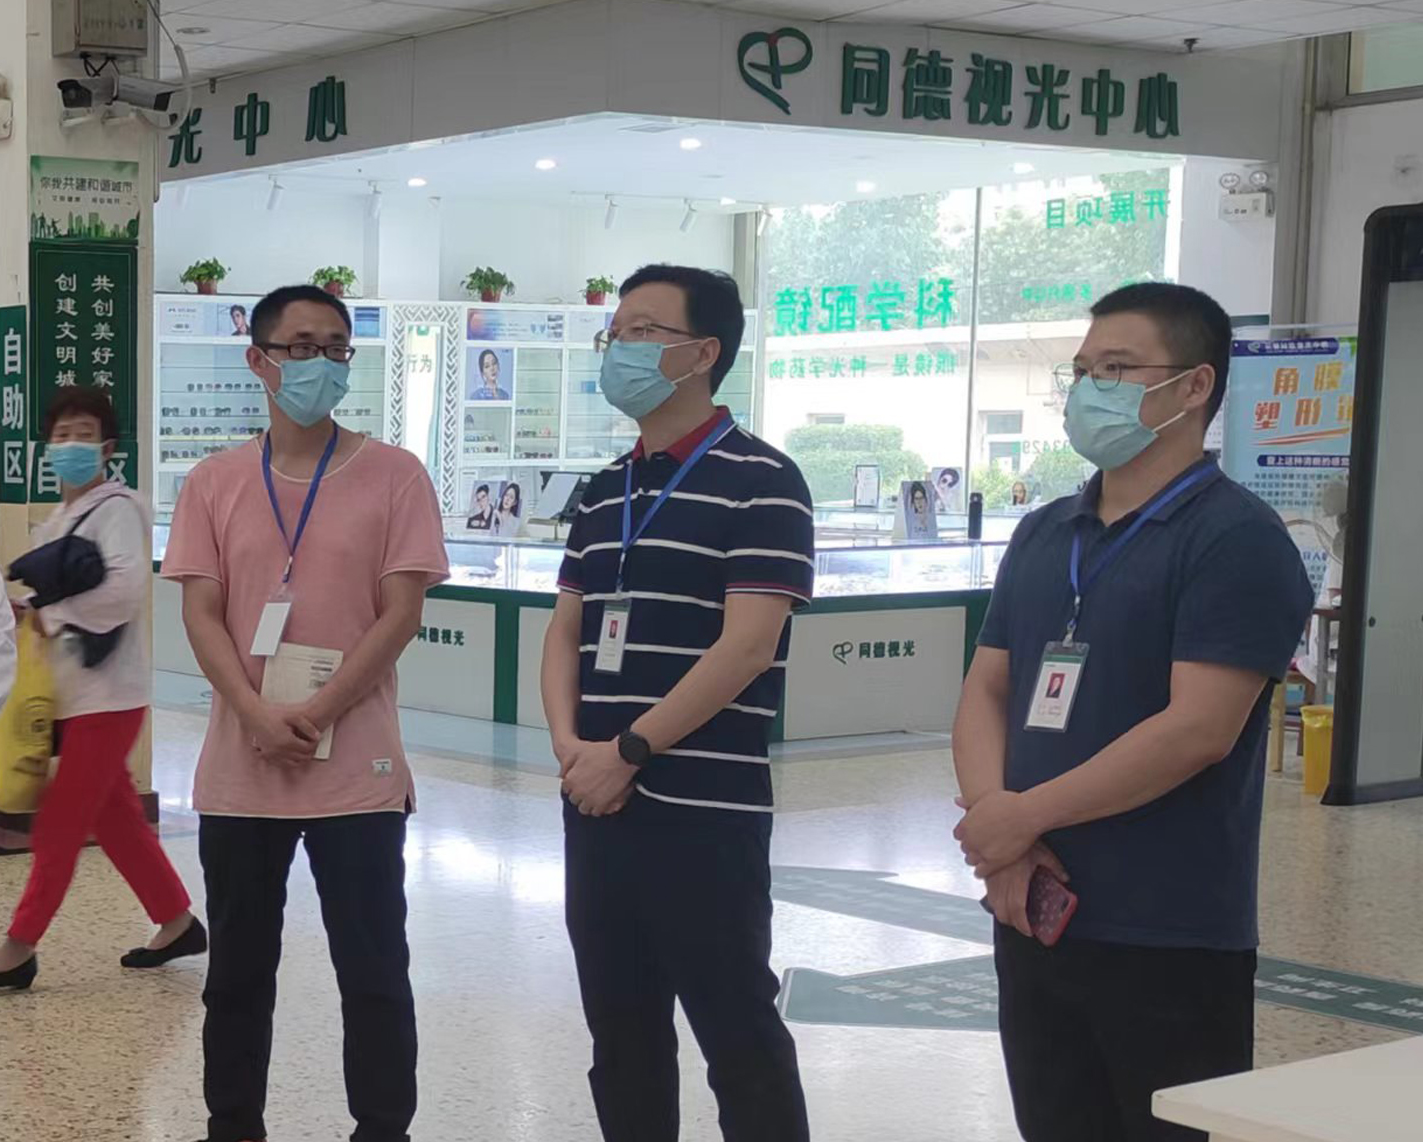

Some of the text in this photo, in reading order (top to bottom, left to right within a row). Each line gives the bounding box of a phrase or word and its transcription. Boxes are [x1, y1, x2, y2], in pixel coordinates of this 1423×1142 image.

[168, 76, 347, 168] 光中心
[840, 42, 1180, 139] 同德视光中心
[90, 274, 115, 406] 共创美好家
[1273, 361, 1343, 396] 角膜
[1, 328, 26, 485] 自助区
[37, 452, 129, 495] 自区
[858, 640, 916, 659] 同德视光
